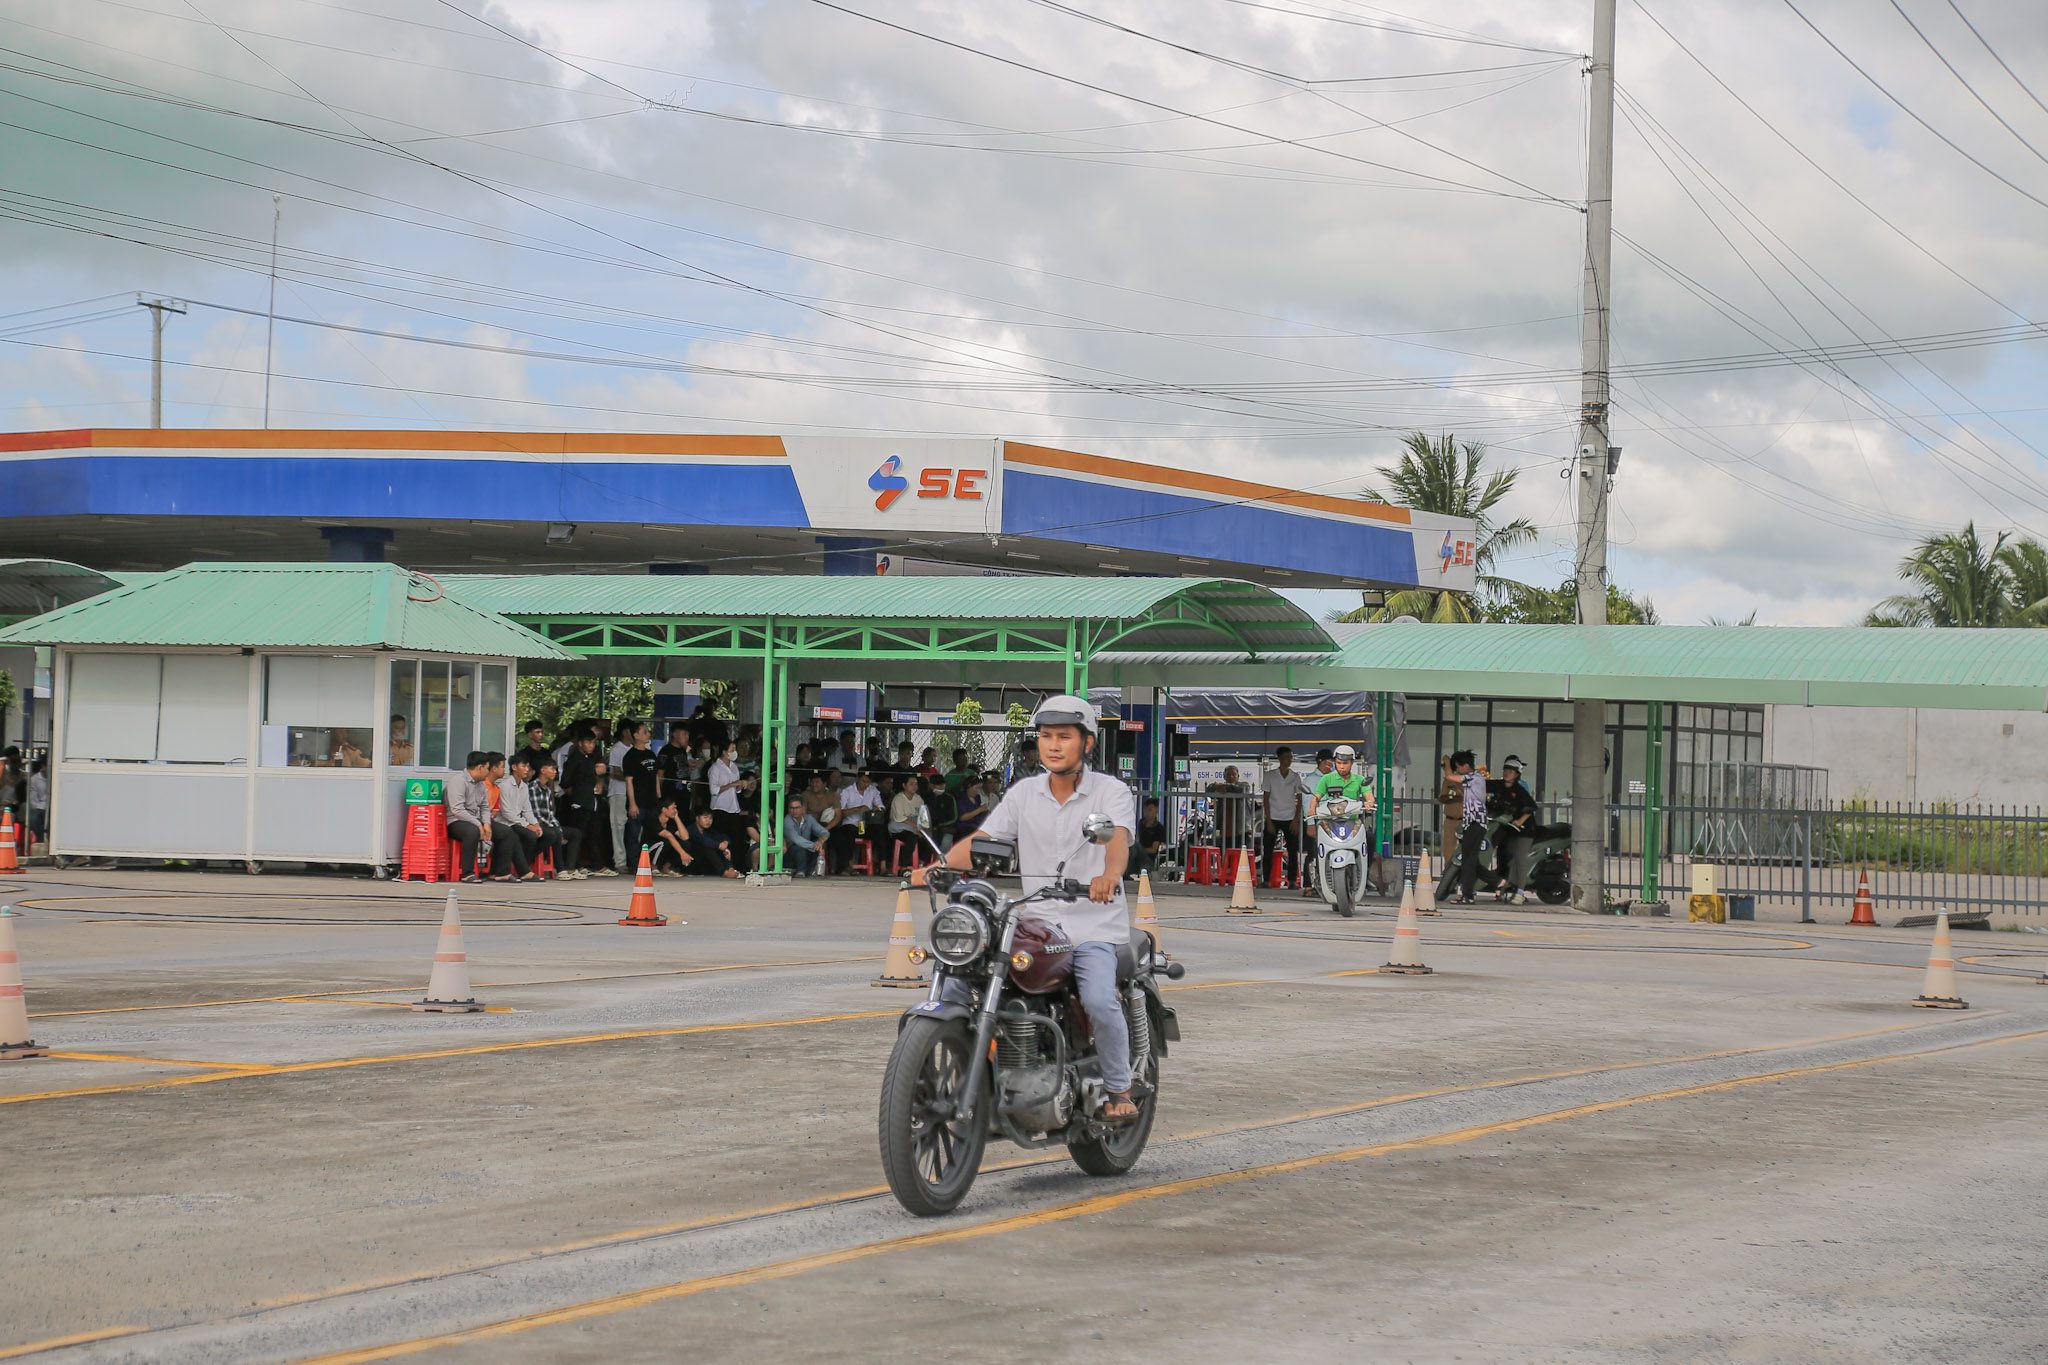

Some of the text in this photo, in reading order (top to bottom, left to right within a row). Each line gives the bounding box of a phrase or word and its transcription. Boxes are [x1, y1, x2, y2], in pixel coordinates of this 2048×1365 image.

[917, 468, 987, 499] SE
[1455, 541, 1475, 565] SE
[1197, 771, 1209, 779] 65H
